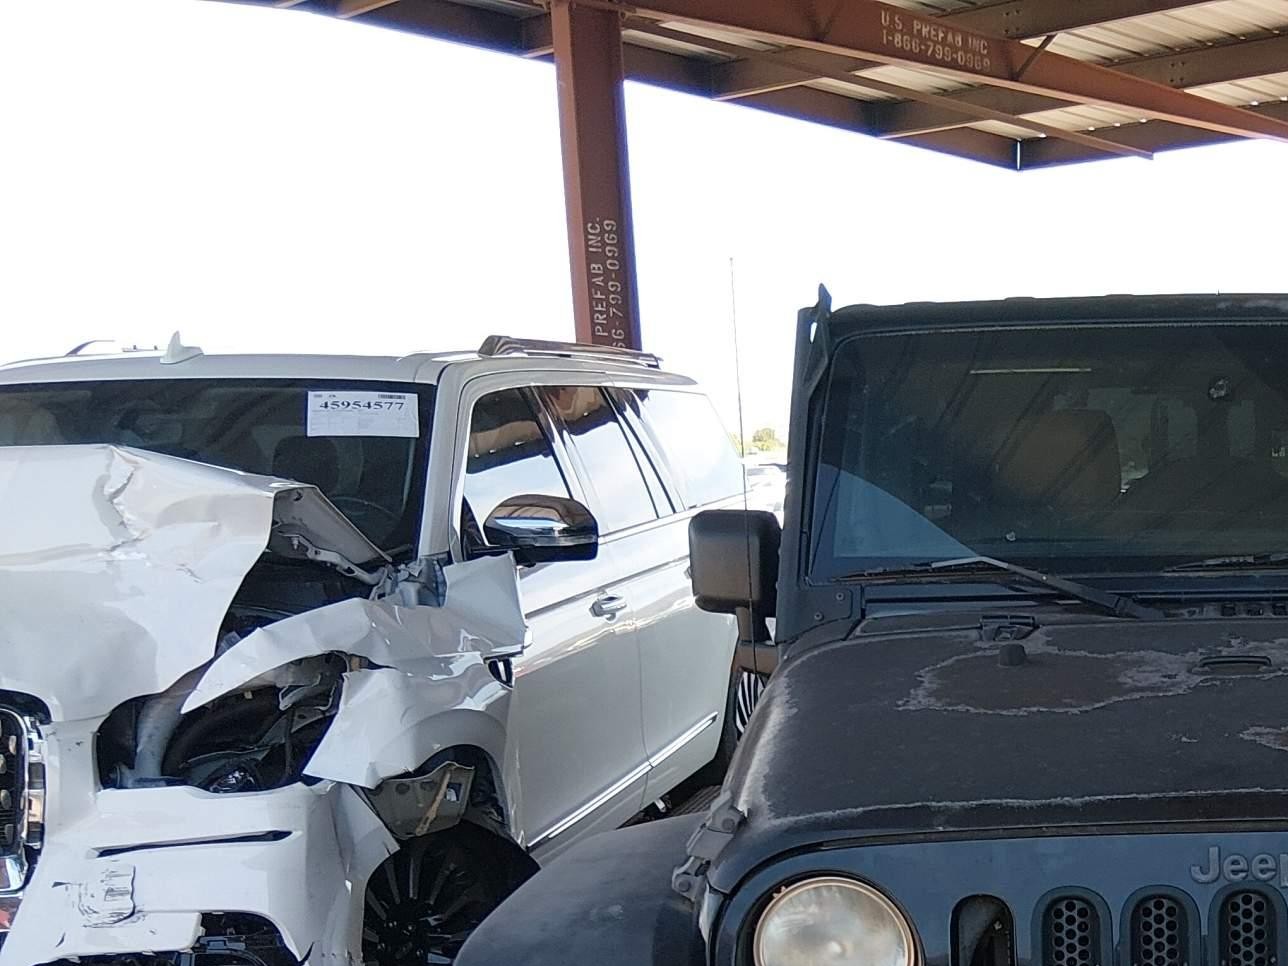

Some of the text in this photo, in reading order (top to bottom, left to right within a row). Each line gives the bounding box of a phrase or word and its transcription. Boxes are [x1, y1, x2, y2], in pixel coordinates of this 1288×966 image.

[881, 9, 906, 32] U.S.
[913, 19, 963, 48] PREFAB
[587, 217, 609, 337] PREFAB INC.
[319, 400, 405, 411] 45954577
